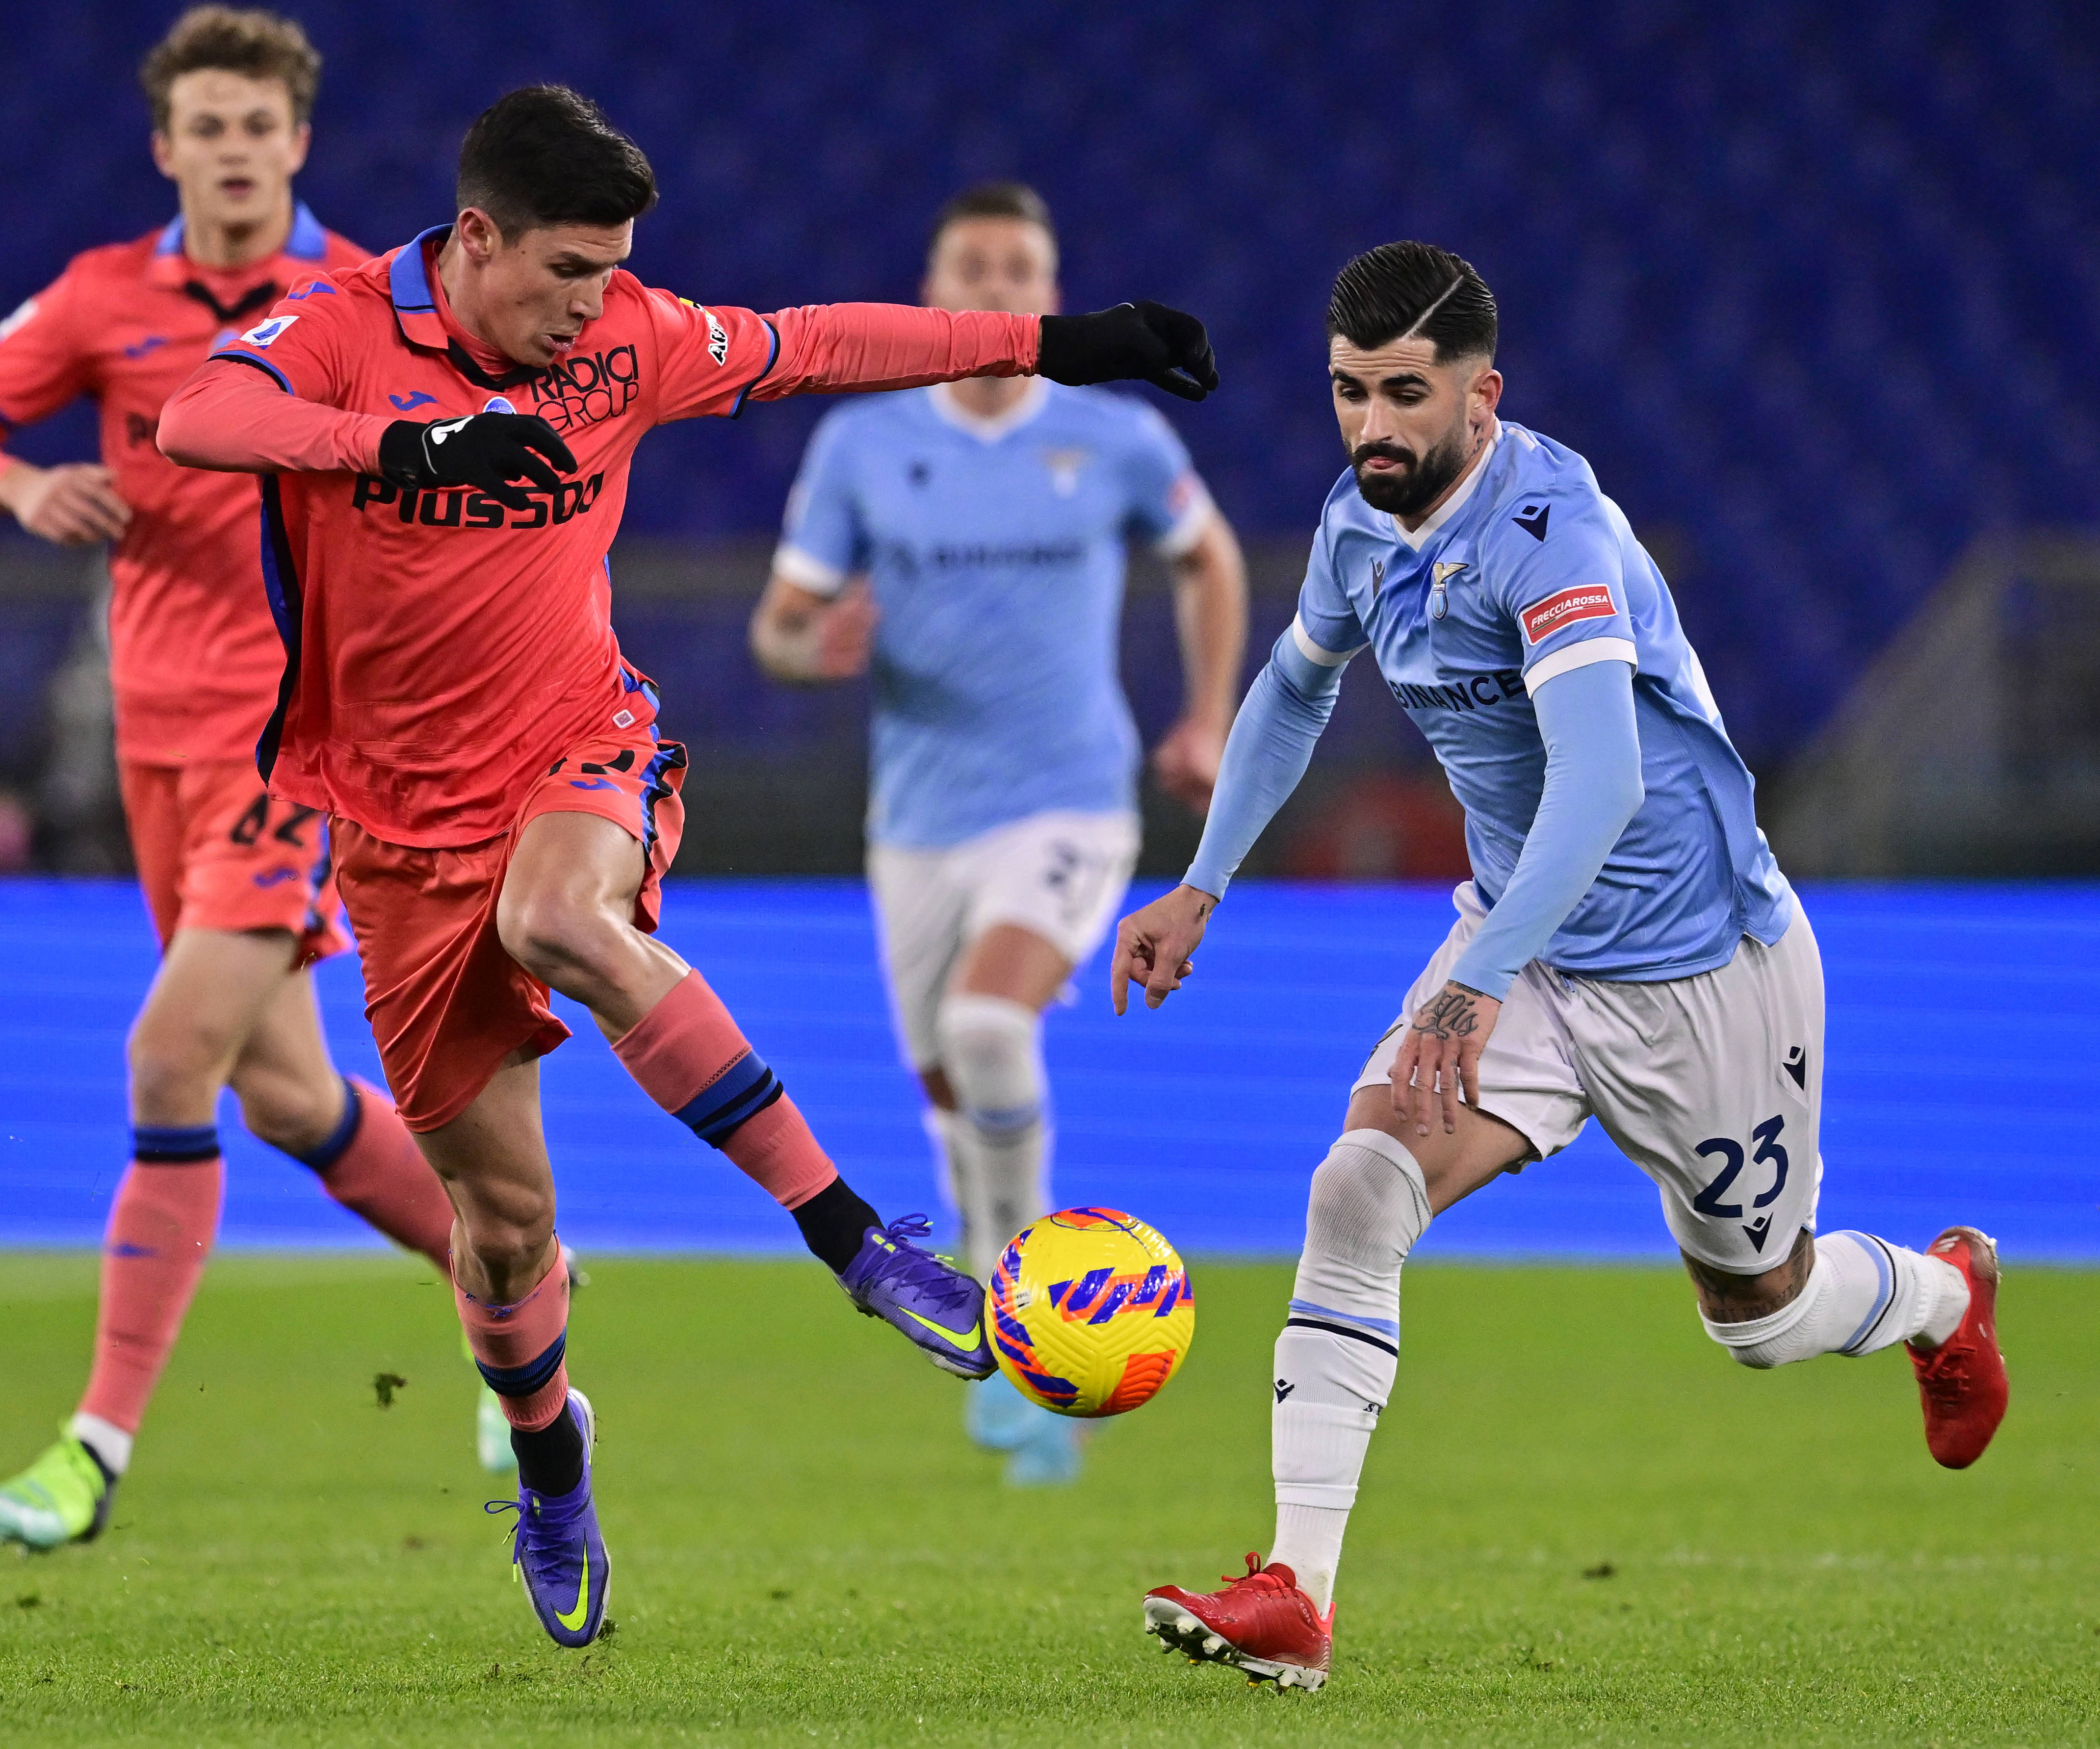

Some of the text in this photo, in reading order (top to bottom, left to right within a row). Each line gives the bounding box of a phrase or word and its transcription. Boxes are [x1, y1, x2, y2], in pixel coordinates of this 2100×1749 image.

[530, 344, 639, 403] RADICI
[536, 382, 639, 432] GROUP
[1531, 594, 1608, 629] FRECCIAROSSA
[1389, 668, 1527, 712] BINANCE
[1693, 1114, 1789, 1218] 23
